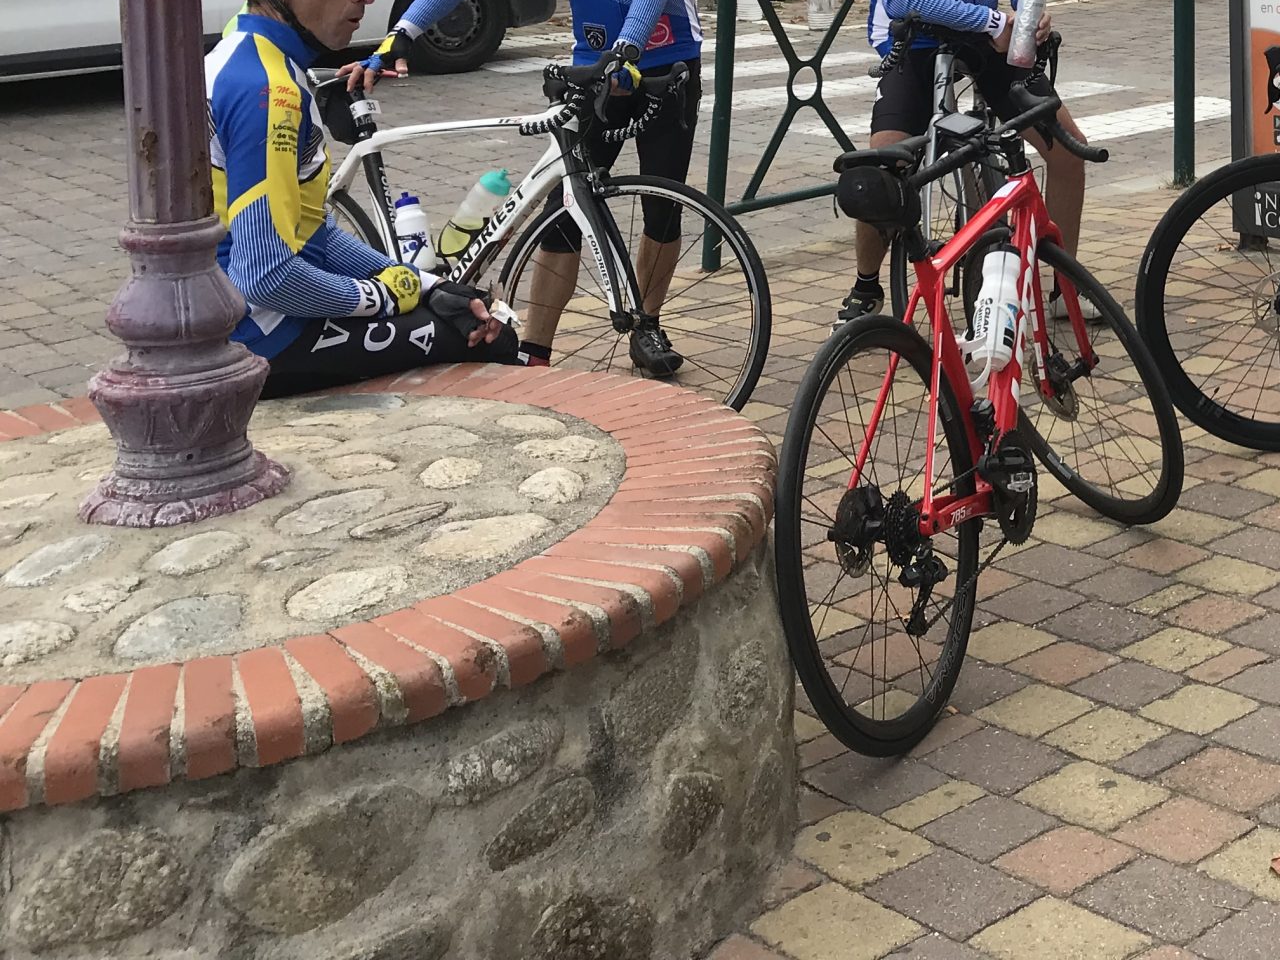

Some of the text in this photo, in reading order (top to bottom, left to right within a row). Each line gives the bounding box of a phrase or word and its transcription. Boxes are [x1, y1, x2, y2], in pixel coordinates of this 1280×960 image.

[1260, 5, 1273, 14] en
[451, 185, 525, 282] ONDRIEST
[950, 506, 966, 525] 785
